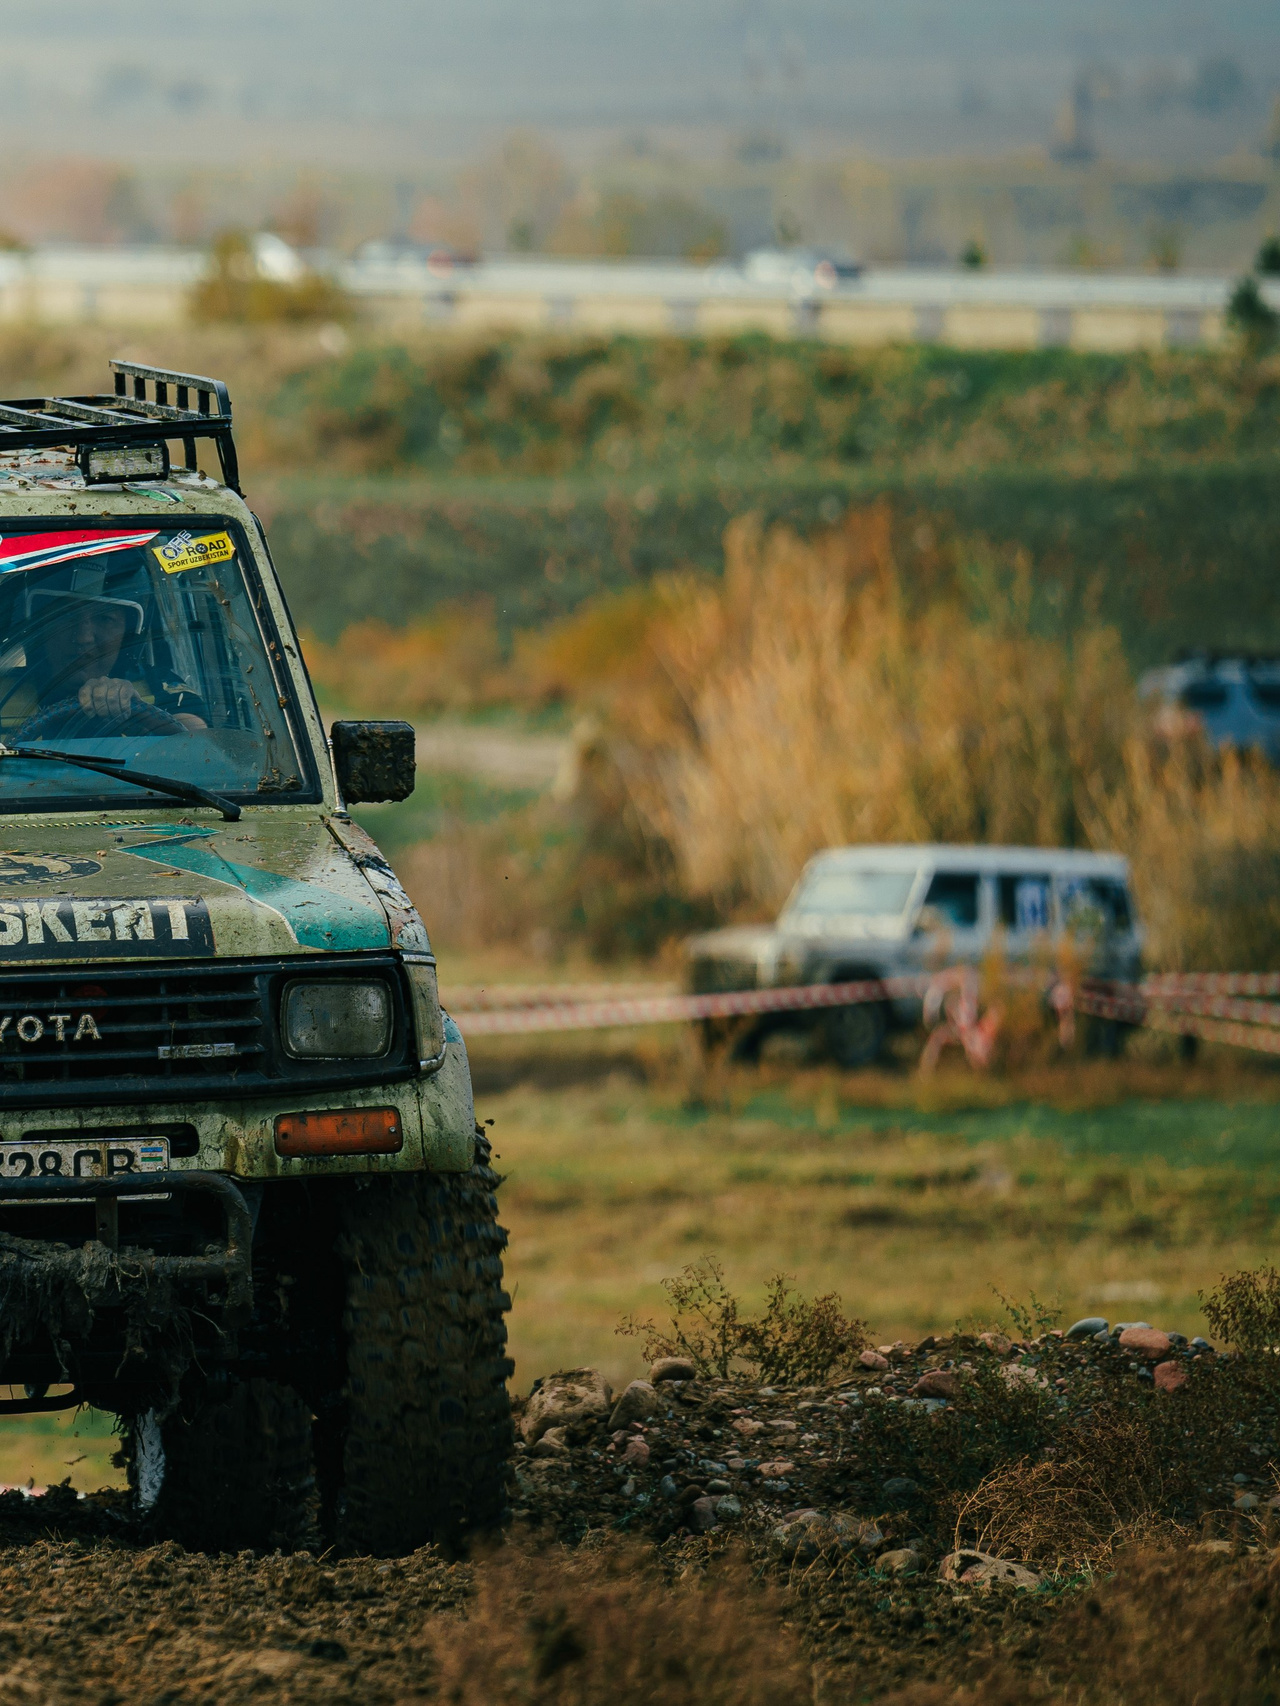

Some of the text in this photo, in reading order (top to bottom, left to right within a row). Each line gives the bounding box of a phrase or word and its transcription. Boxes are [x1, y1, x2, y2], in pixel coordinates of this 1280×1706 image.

[161, 529, 227, 560] OFF ROAD
[167, 550, 229, 569] SPORT UZBEKISTAN
